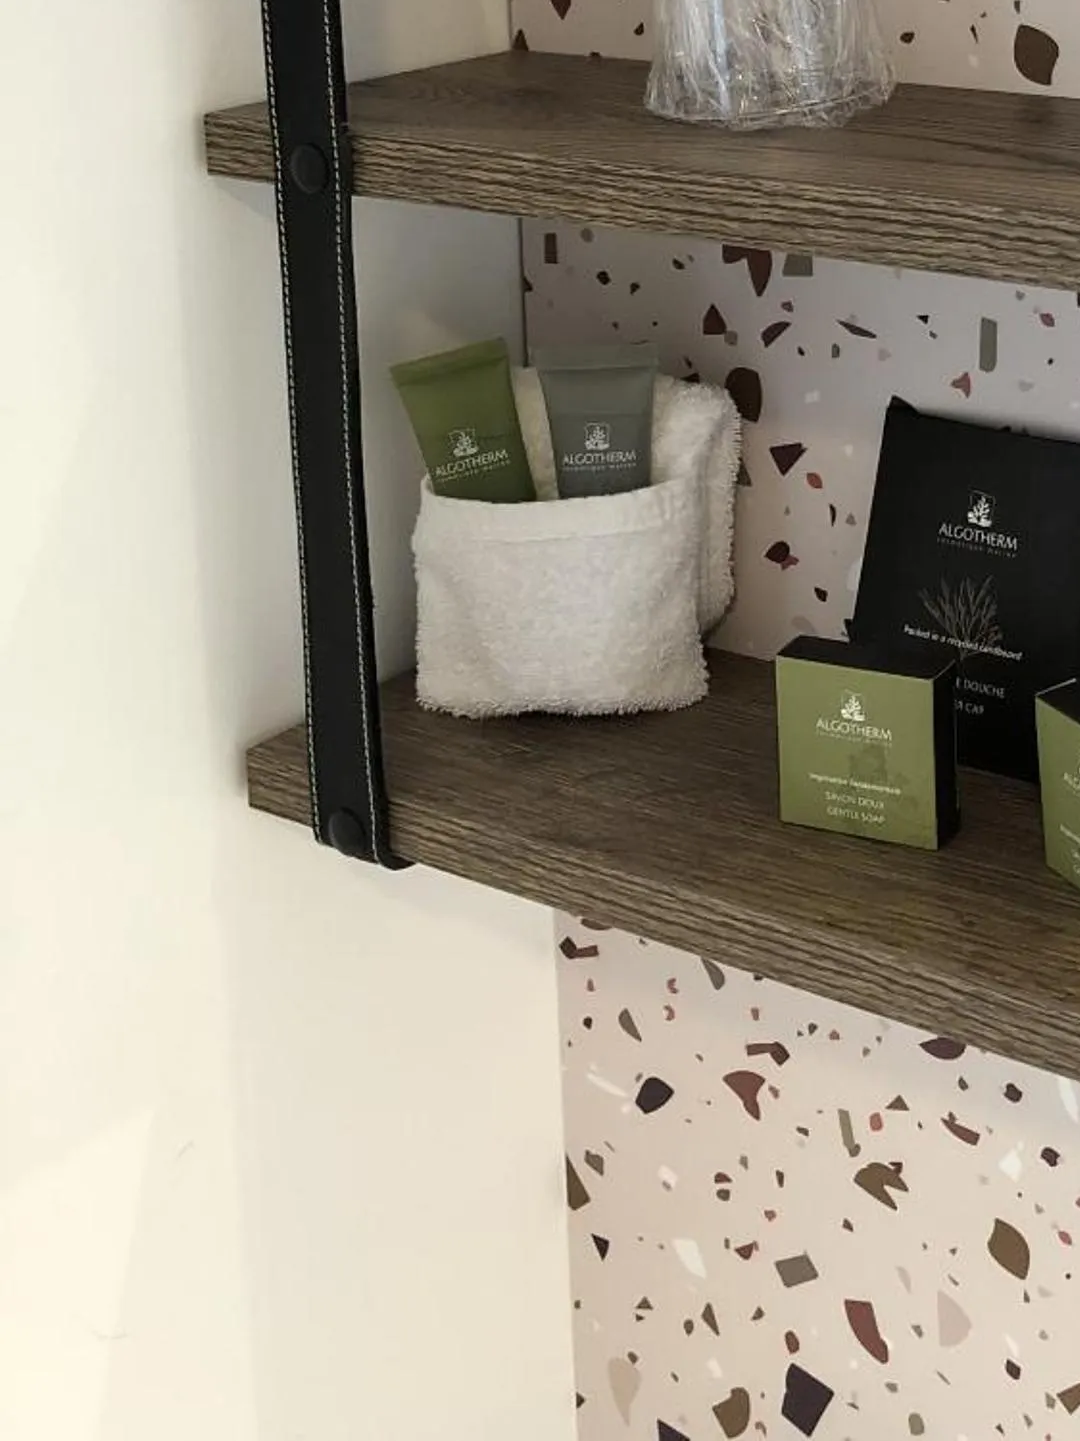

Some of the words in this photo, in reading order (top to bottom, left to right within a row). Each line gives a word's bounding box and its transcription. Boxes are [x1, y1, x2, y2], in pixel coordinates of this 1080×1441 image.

[434, 449, 509, 477] ALGOTHERM
[563, 450, 637, 466] ALGOTHERM
[938, 523, 1018, 551] ALGOTHERM
[816, 717, 892, 741] ALGOTHERM
